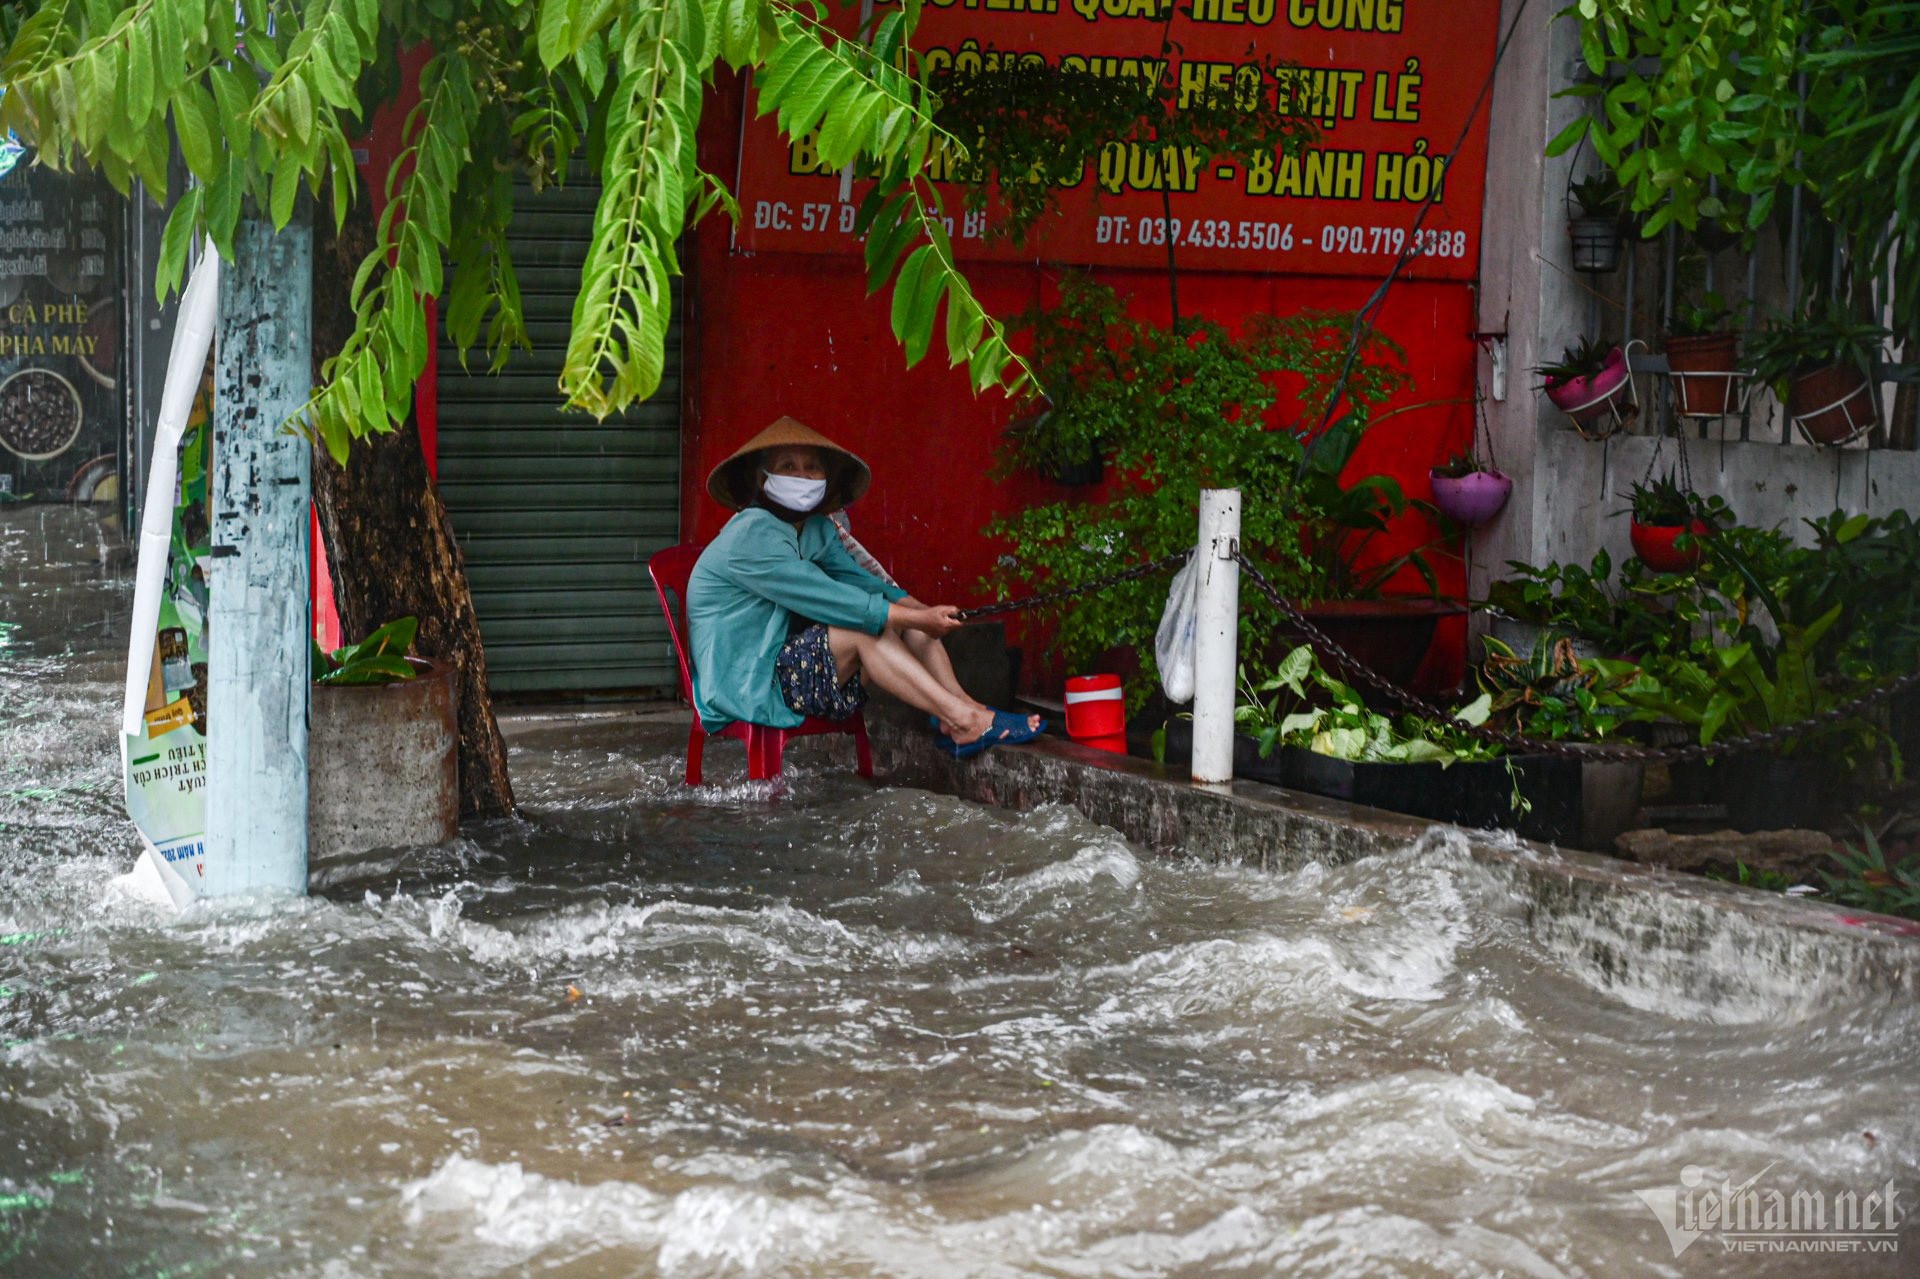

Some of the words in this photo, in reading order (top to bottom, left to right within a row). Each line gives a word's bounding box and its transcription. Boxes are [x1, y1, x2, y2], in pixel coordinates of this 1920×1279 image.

[1372, 57, 1422, 122] LẺ
[1374, 138, 1447, 204] HỎI
[754, 201, 793, 230] ĐC:
[801, 204, 832, 233] 57
[1096, 215, 1130, 246] ĐT:
[1137, 217, 1294, 252] 039.433.5506
[44, 299, 88, 324] PHÊ
[0, 335, 45, 355] PHA
[168, 745, 195, 762] TIÊU
[132, 770, 151, 788] CỦA
[154, 763, 189, 781] TRÍCH
